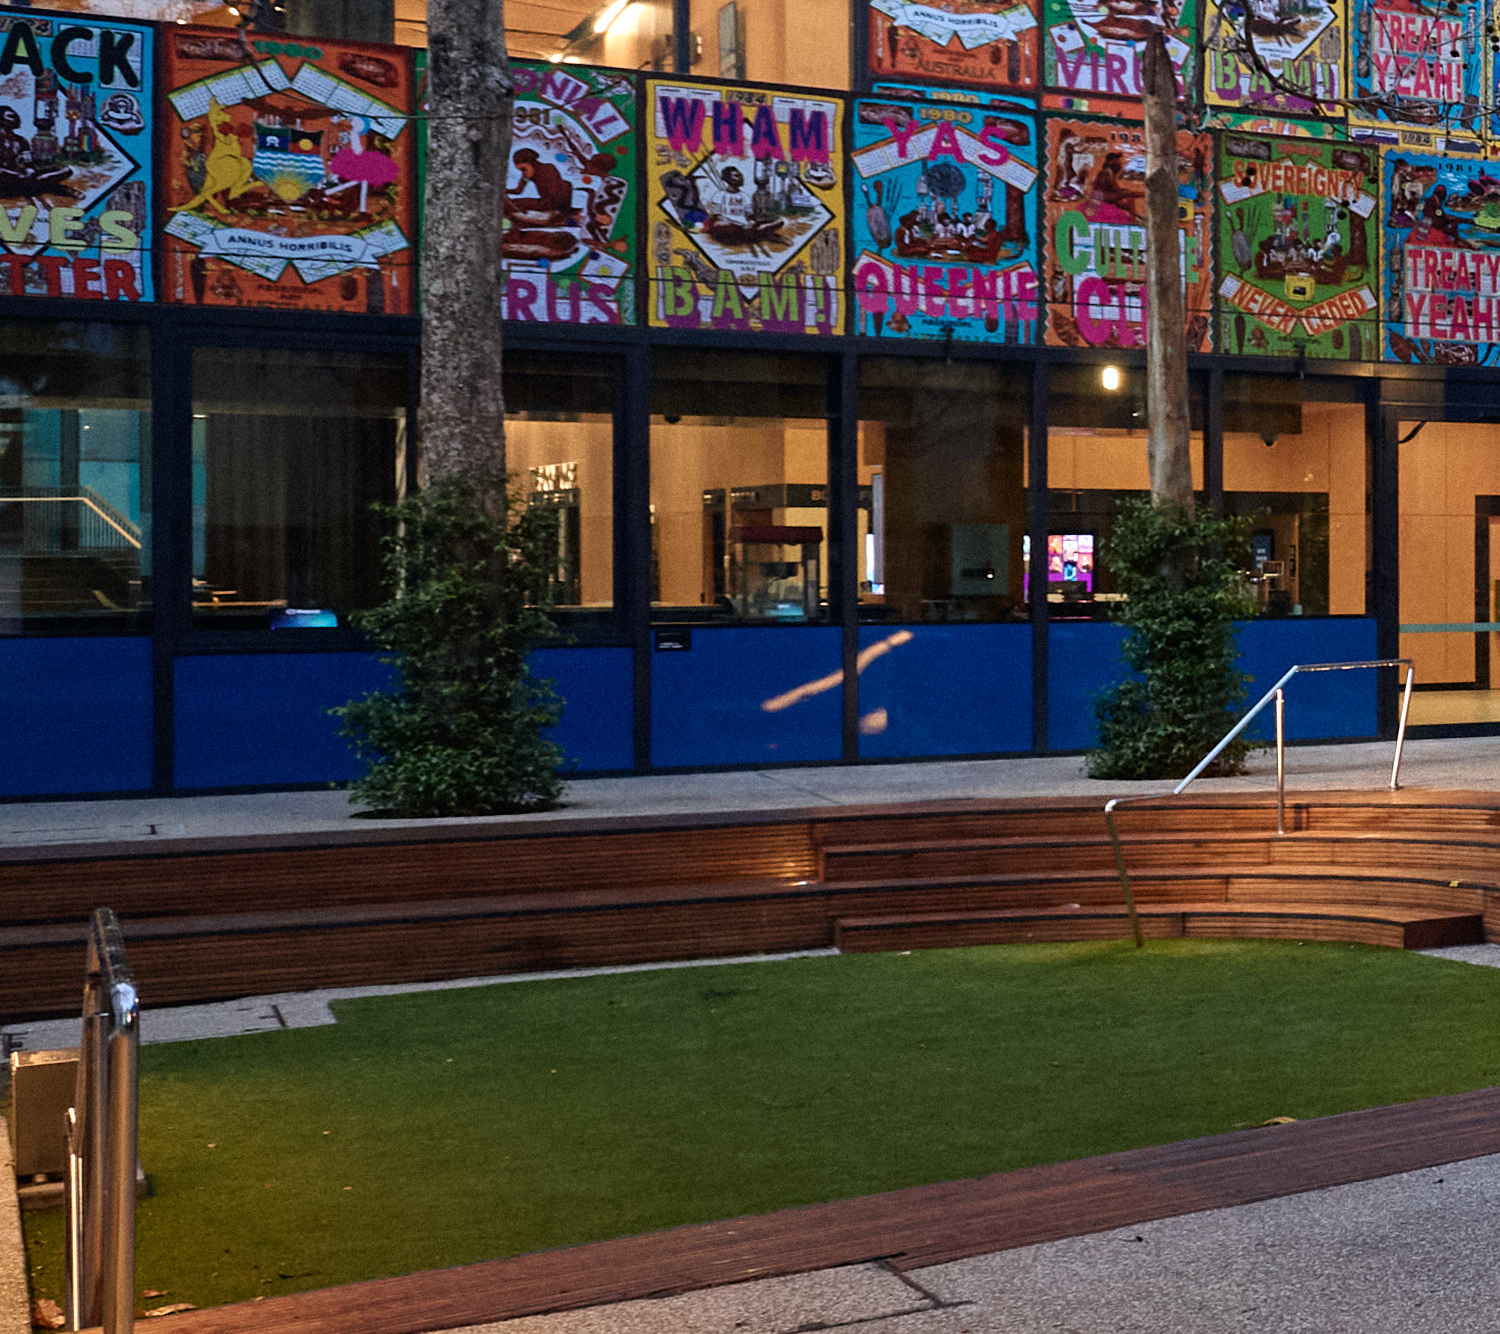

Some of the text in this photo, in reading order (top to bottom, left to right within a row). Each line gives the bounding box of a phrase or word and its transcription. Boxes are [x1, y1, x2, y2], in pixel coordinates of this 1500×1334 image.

[253, 39, 324, 60] 1980
[1374, 12, 1462, 55] TREATY
[914, 60, 997, 79] AUSTRALIA
[1214, 49, 1336, 112] BAM!
[1373, 49, 1464, 101] YEAH!
[659, 94, 829, 163] WHAM
[918, 107, 973, 123] 1980
[883, 117, 1010, 167] YAS
[1233, 160, 1364, 199] SOVEREIGNTY
[228, 236, 353, 253] ANNUS HORRIBILIS
[1055, 209, 1200, 284] CULTE
[856, 261, 1038, 320] QUEENIE
[1407, 247, 1500, 294] TREATY
[506, 278, 619, 324] RUS
[663, 266, 829, 330] BAM!
[1230, 280, 1369, 336] NEVER CEDED
